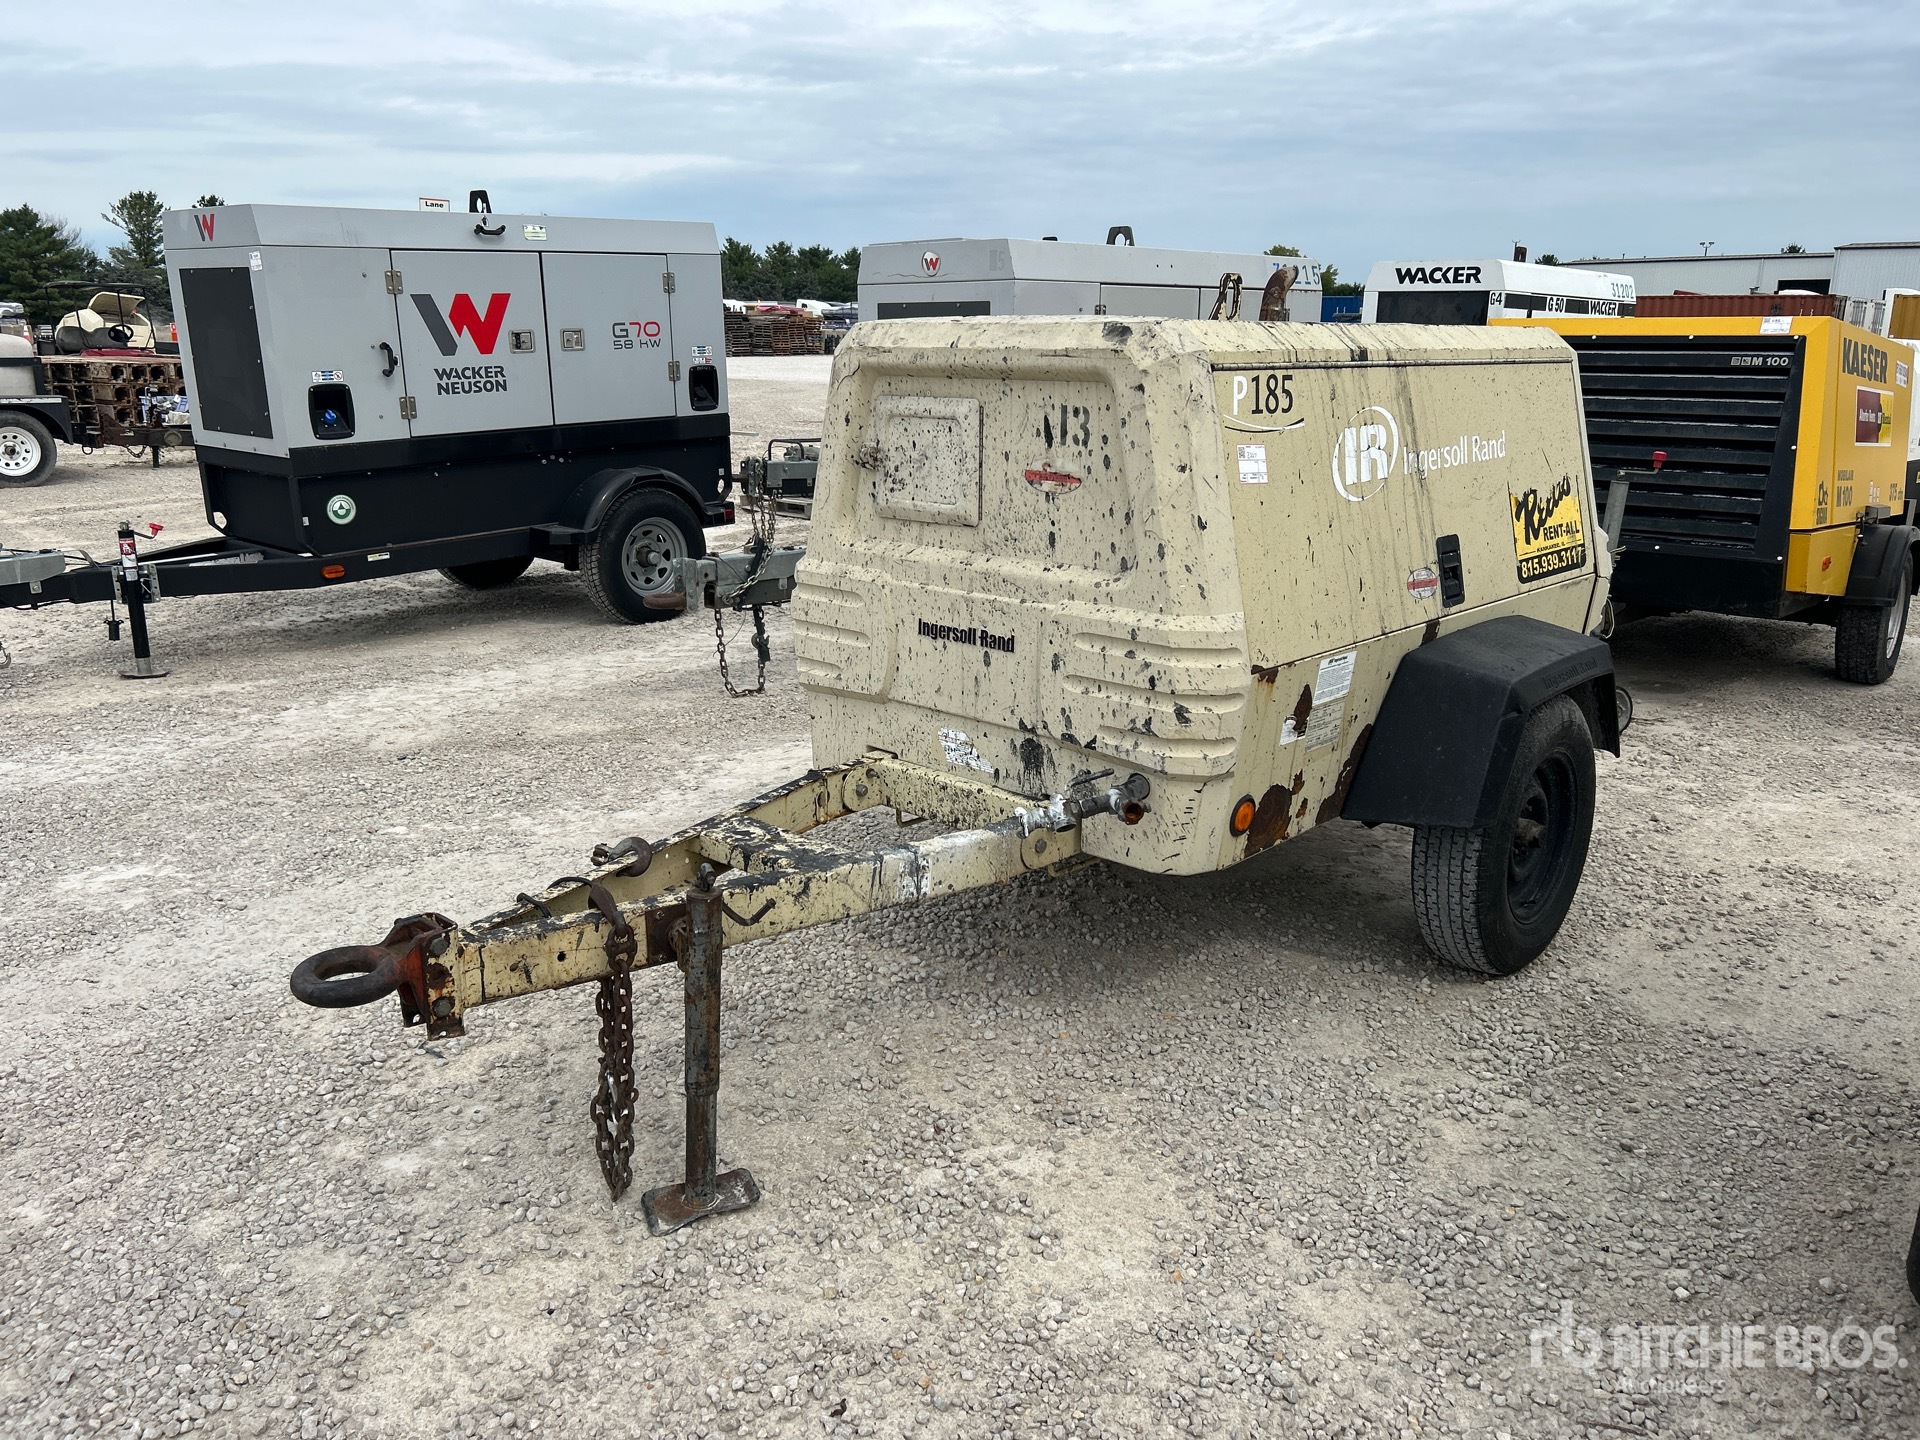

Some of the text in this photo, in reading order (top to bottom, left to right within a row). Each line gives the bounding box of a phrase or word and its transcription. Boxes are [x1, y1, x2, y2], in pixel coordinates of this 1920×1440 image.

[424, 200, 444, 209] Lane
[1395, 266, 1482, 284] WACKER
[1610, 282, 1634, 299] 31202
[1590, 300, 1617, 317] WACKER
[612, 321, 661, 338] G70
[613, 339, 634, 350] 58
[1752, 357, 1789, 366] M 100
[1842, 337, 1888, 384] KAESER
[433, 365, 506, 381] WACKER
[437, 379, 507, 395] NEUSON
[1403, 429, 1506, 480] Ingersoll Rand
[1543, 520, 1580, 542] RENT-ALL
[1521, 546, 1583, 578] 815.939.3117
[917, 617, 977, 646] Ingersoll
